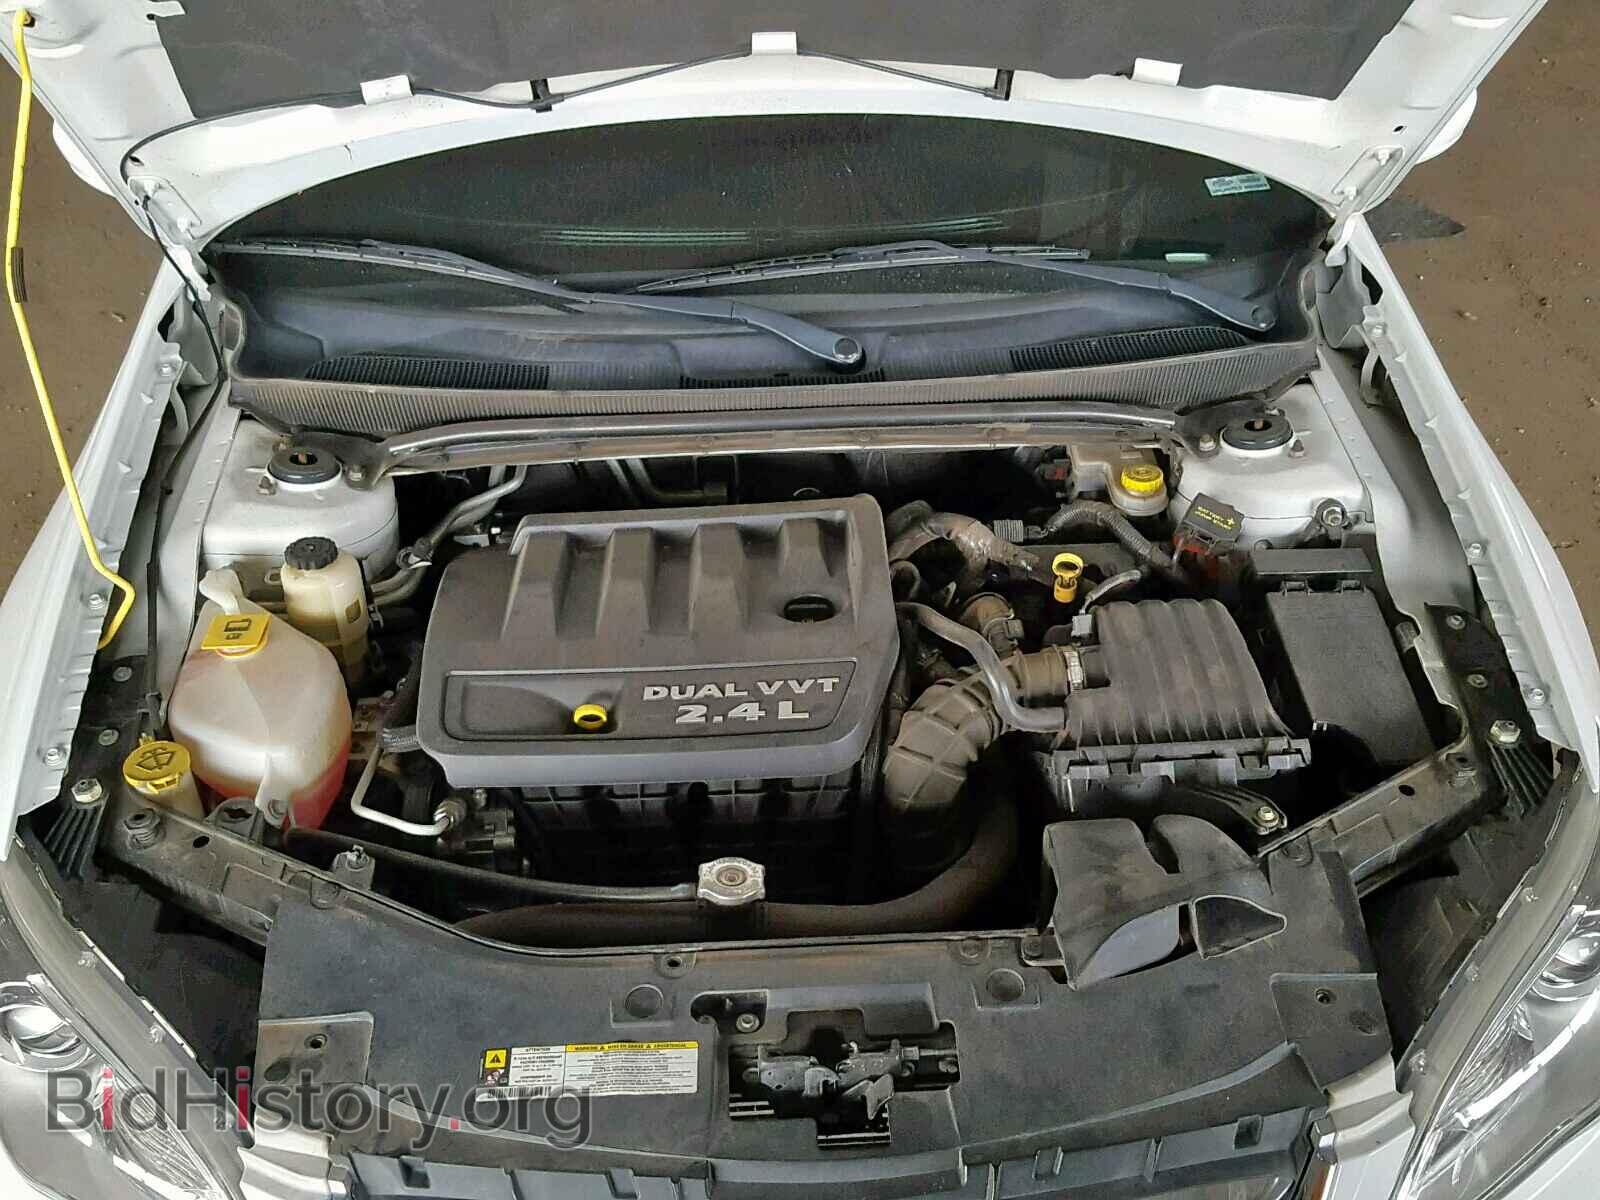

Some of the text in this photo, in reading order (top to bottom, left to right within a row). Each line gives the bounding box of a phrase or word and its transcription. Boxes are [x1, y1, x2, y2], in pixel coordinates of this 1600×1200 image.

[643, 677, 840, 702] DUAL VVT
[675, 700, 810, 725] 2.4 L
